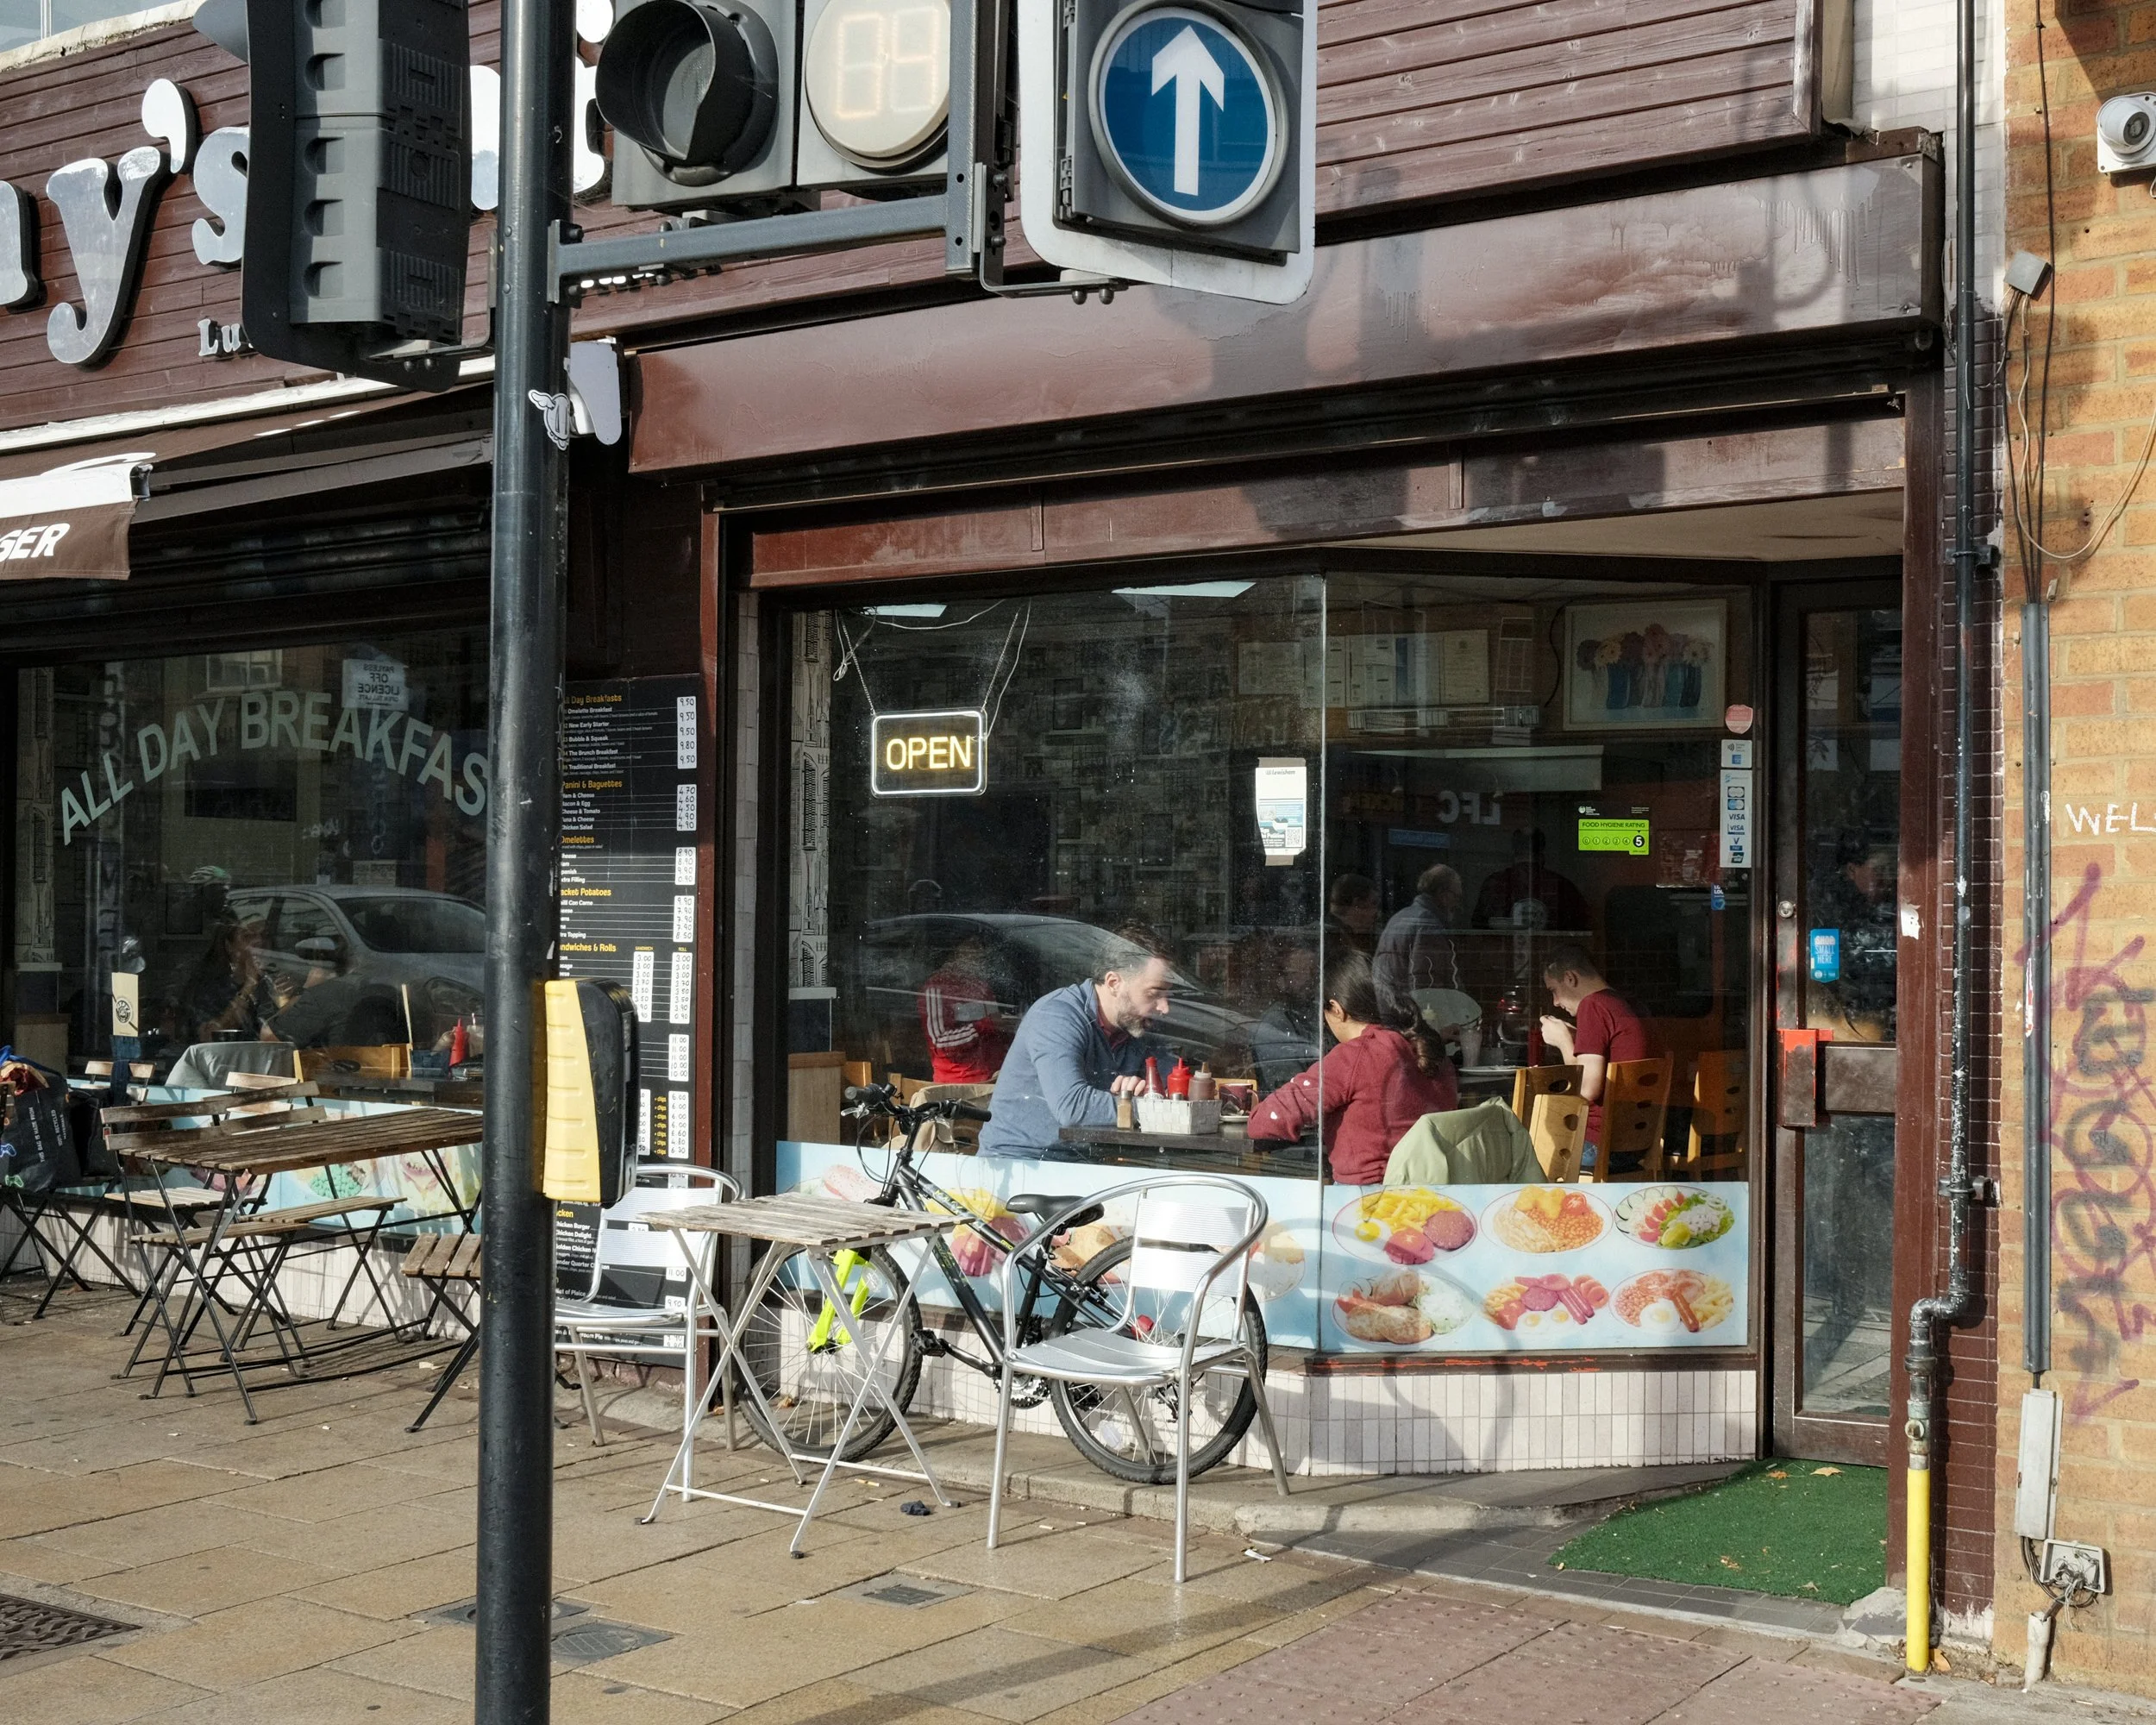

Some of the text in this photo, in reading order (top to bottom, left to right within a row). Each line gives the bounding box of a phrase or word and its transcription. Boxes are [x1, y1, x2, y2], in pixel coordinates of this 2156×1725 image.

[572, 694, 622, 706] Day Breakfasts
[680, 698, 694, 706] 9.50
[680, 712, 695, 721] 9.50
[680, 727, 695, 736] 9.50
[680, 741, 695, 750] 9.80
[887, 736, 971, 769] OPEN
[680, 755, 695, 764] 9.50
[60, 691, 490, 846] ALL DAY BREAKFAS
[588, 780, 622, 790] Baguettes
[2065, 802, 2156, 836] WEL
[580, 888, 611, 896] Potatoes
[1815, 945, 1834, 955] SMALL
[1817, 954, 1833, 963] HERE
[51, 1109, 60, 1133] RECYCLED
[573, 1222, 591, 1231] Burger
[574, 1231, 592, 1239] Delight
